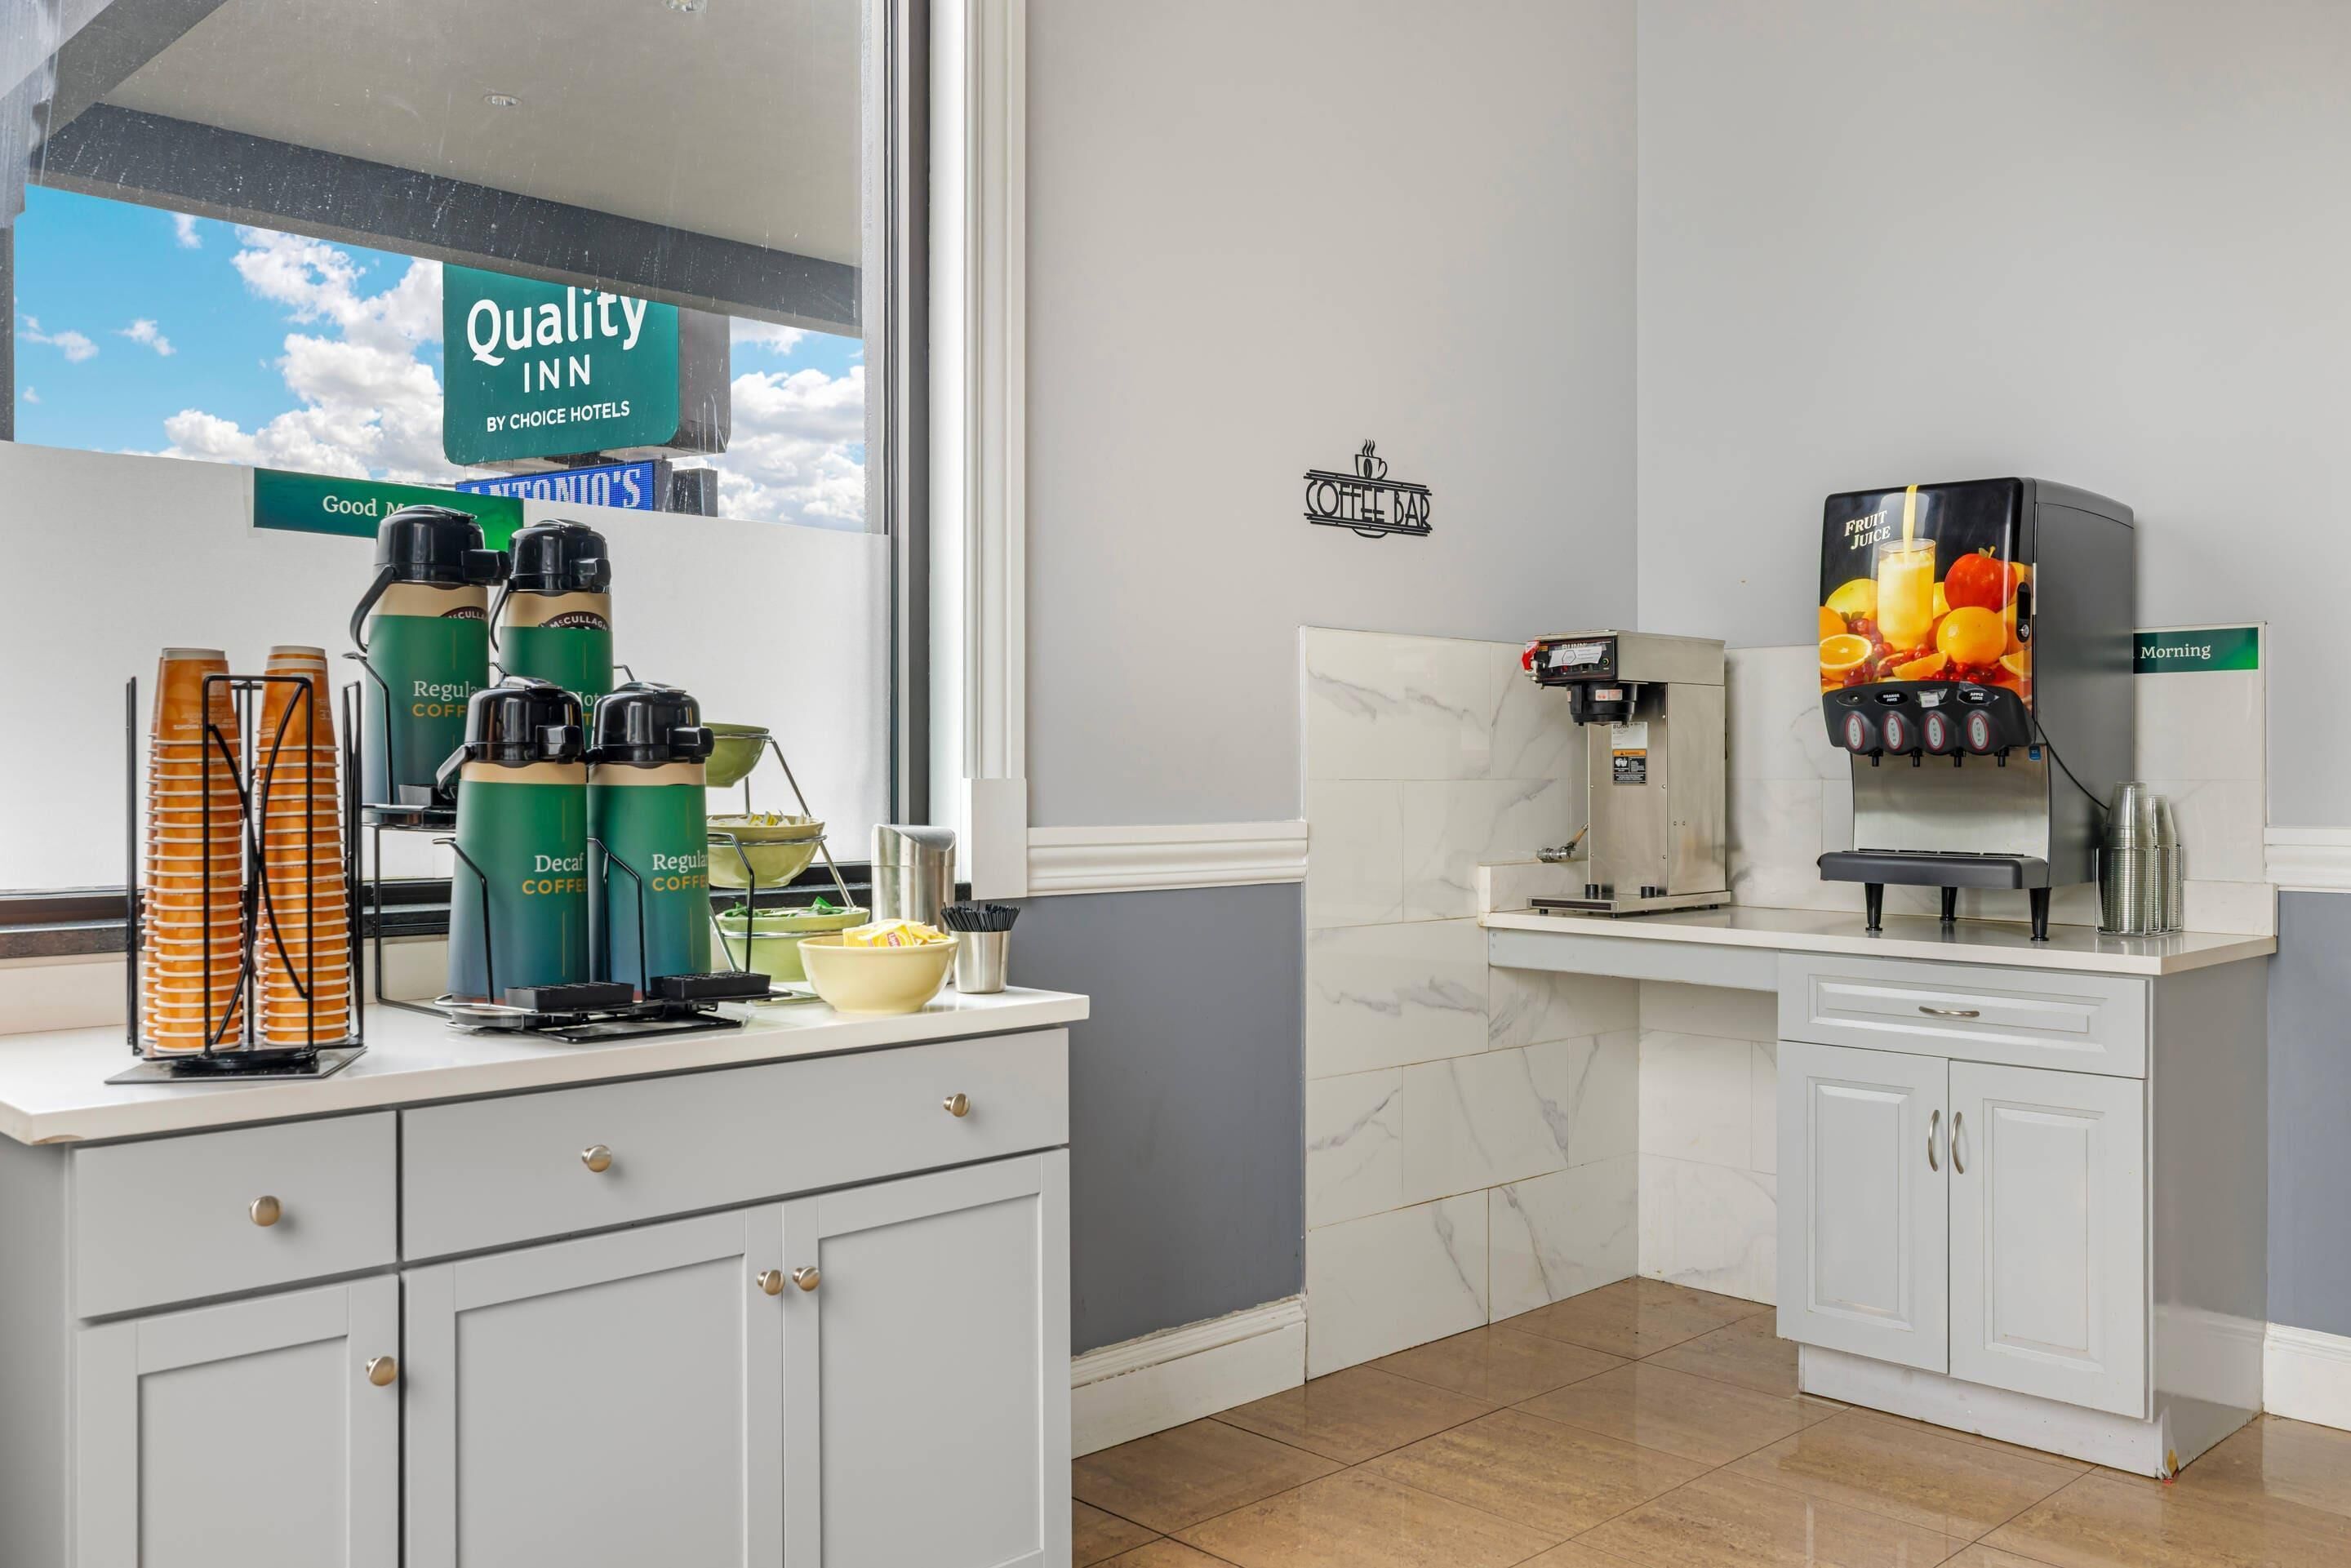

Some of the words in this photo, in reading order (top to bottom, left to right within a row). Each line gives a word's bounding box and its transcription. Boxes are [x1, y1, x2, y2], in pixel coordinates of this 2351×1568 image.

[467, 286, 647, 366] Quality
[524, 353, 590, 393] INN
[487, 415, 506, 433] BY
[509, 408, 567, 429] CHOICE
[571, 401, 631, 422] HOTELS
[469, 469, 642, 509] TONIO'S
[322, 495, 378, 517] Good
[1306, 478, 1385, 524] COFFEE
[1393, 490, 1431, 531] BAR
[1844, 509, 1887, 537] FRUIT
[1850, 525, 1891, 550] JUICE
[2140, 643, 2211, 660] Morning
[413, 680, 485, 702] Regula
[412, 703, 467, 718] COFF
[534, 852, 584, 873] Decaf
